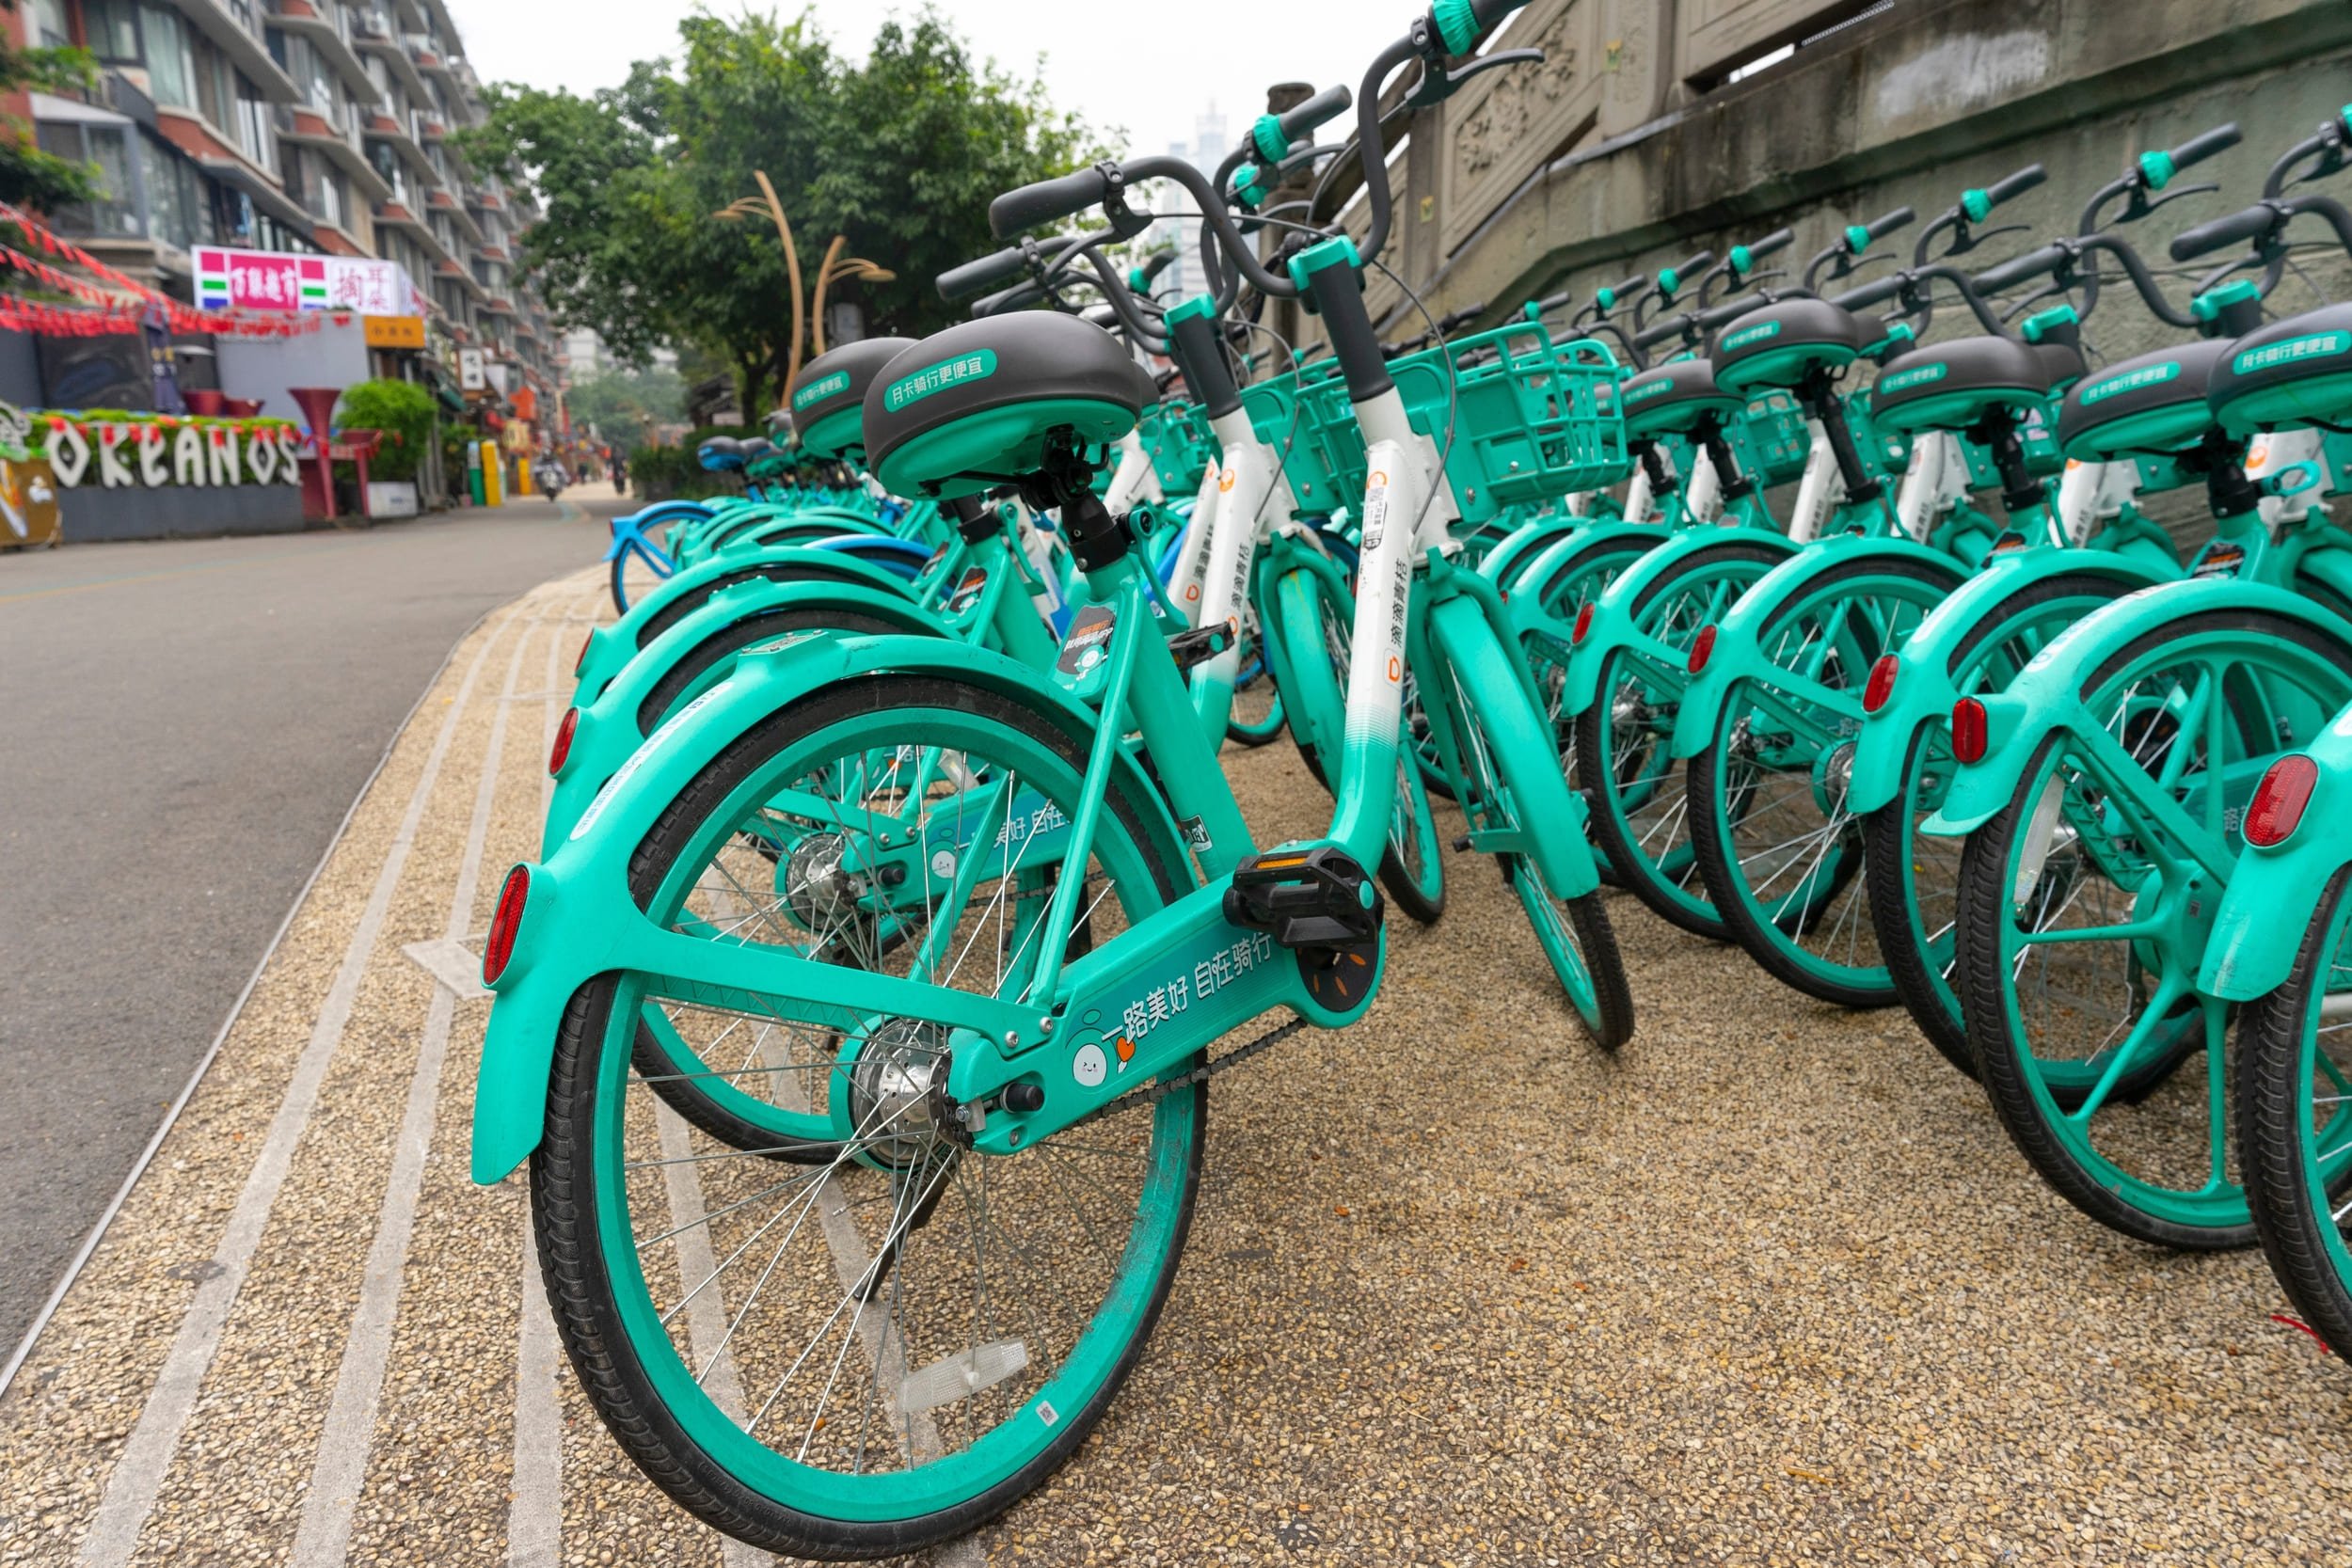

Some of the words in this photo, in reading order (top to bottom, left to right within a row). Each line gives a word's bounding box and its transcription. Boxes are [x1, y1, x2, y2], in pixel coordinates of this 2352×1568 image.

[892, 356, 983, 405] 月卡骑行更便宜
[1391, 558, 1407, 649] 滴滴青桔
[1101, 975, 1189, 1044] 一路美好
[1194, 932, 1271, 999] 自在骑行
